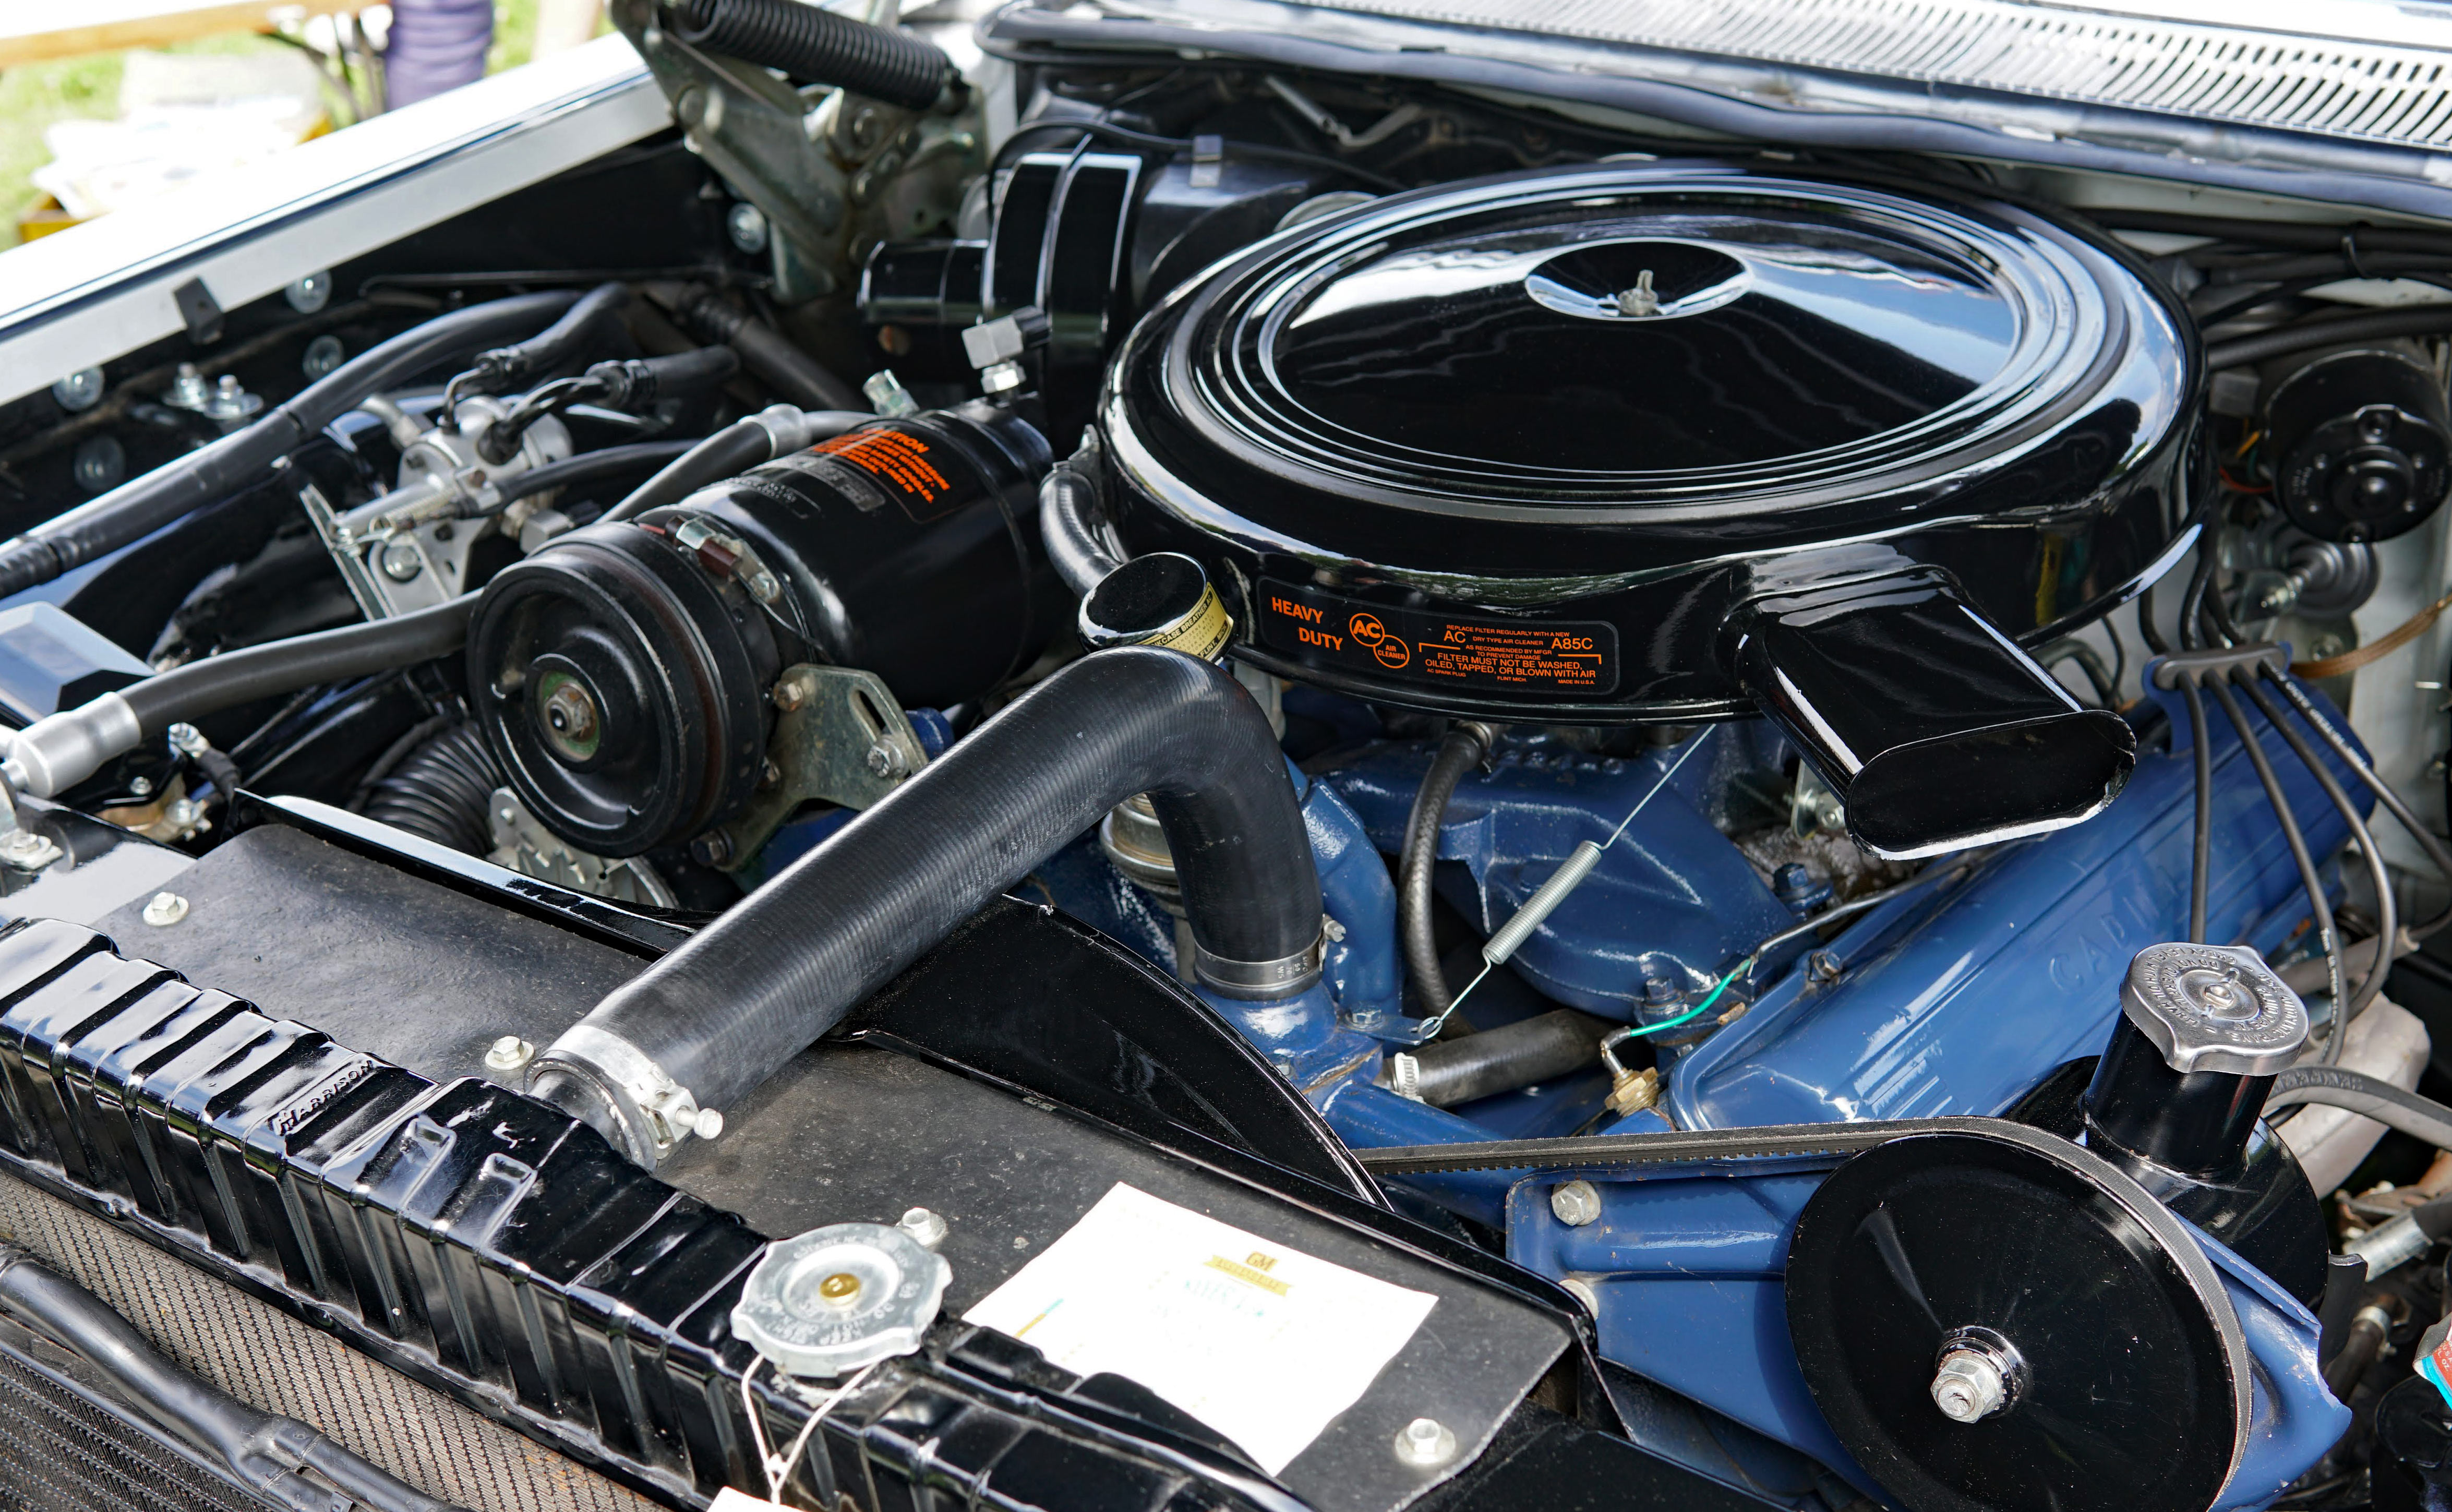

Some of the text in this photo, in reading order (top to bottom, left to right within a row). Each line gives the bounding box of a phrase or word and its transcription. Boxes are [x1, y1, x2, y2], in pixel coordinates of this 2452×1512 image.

[1271, 597, 1323, 624] HEAVY
[1153, 595, 1212, 645] NKCASE BREATHER AC
[1353, 620, 1381, 639] AC
[1299, 627, 1343, 651] DUTY
[1444, 630, 1466, 643] AC
[1551, 637, 1593, 650] A85C
[1377, 650, 1405, 661] CLEANER
[1438, 652, 1469, 663] FILTER
[1471, 656, 1498, 666] MUST
[1538, 661, 1582, 670] WASHED,
[1425, 659, 1455, 670] OILED,
[1457, 663, 1497, 675] TAPPED,
[1516, 667, 1551, 677] BLOWN
[2149, 947, 2186, 962] LEVEL
[2191, 947, 2237, 965] CHECK
[2174, 959, 2196, 969] NOT
[2198, 959, 2220, 969] DO
[2148, 985, 2165, 1001] OIL
[269, 1060, 375, 1136] HARRISON
[1246, 1251, 1276, 1271] GM
